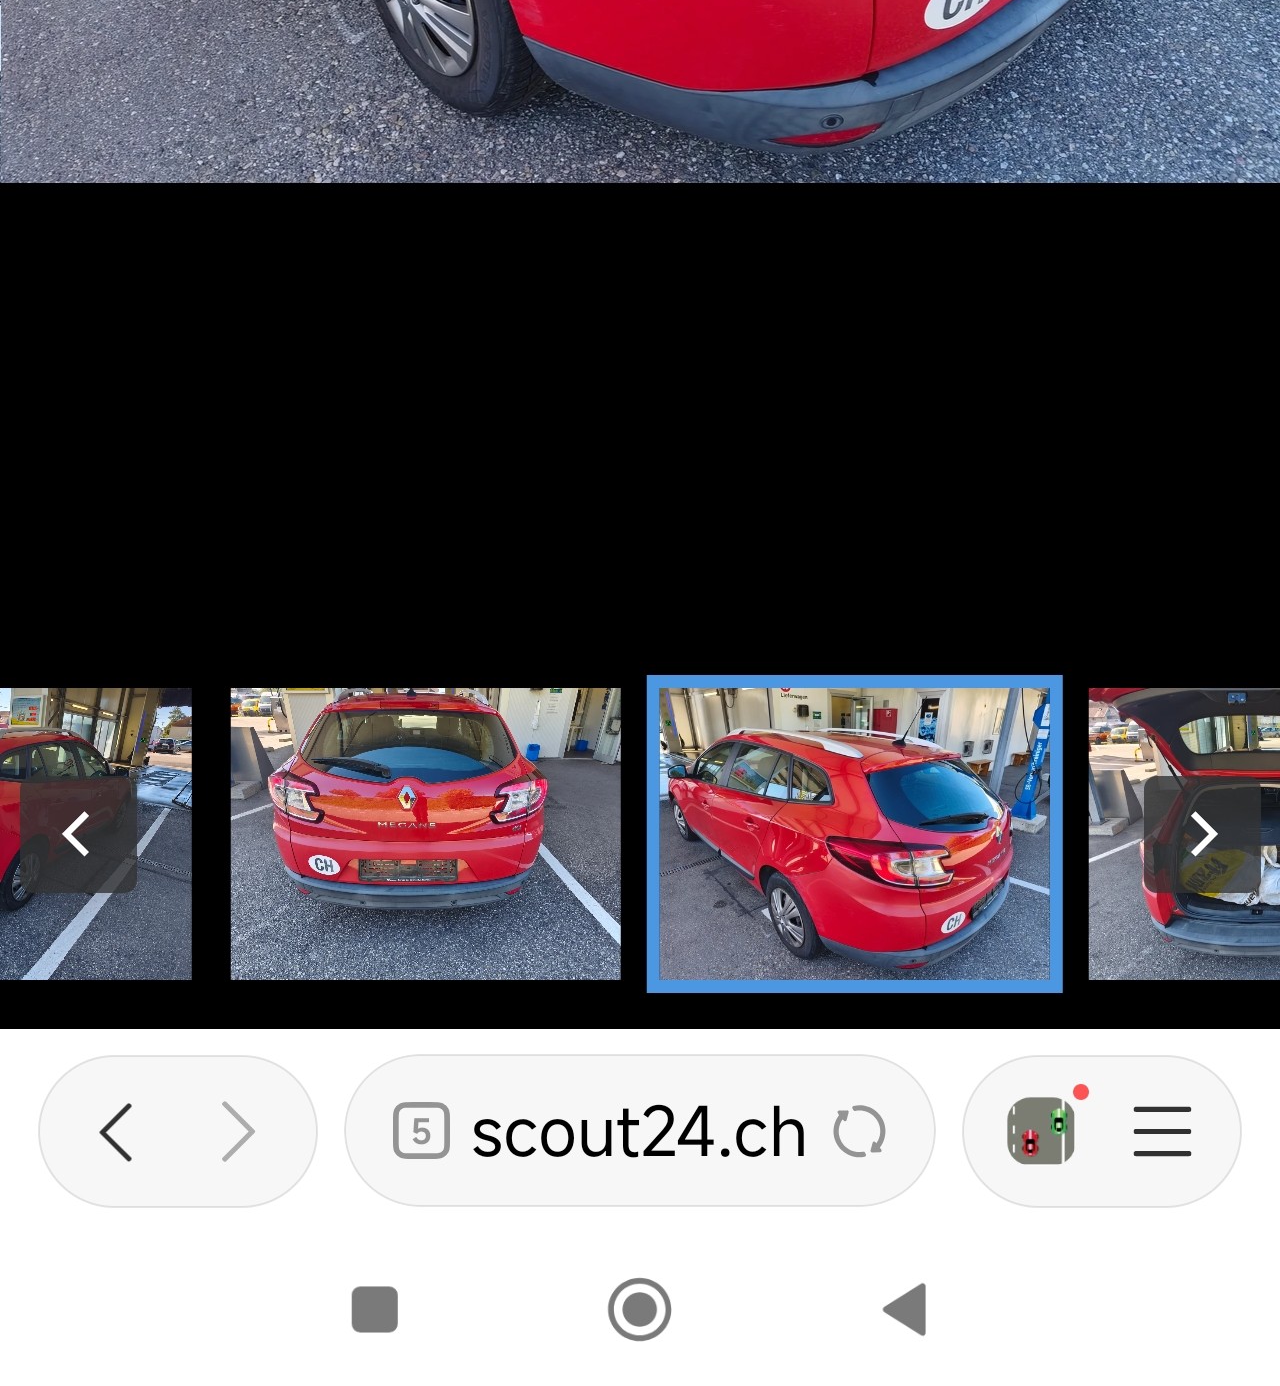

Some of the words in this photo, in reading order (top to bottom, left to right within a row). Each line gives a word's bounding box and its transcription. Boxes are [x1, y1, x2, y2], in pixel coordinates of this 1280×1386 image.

[377, 821, 436, 829] MEGANE
[314, 858, 335, 873] CH
[946, 914, 962, 931] CH
[412, 1117, 431, 1145] 5
[472, 1105, 805, 1157] scout24.ch
